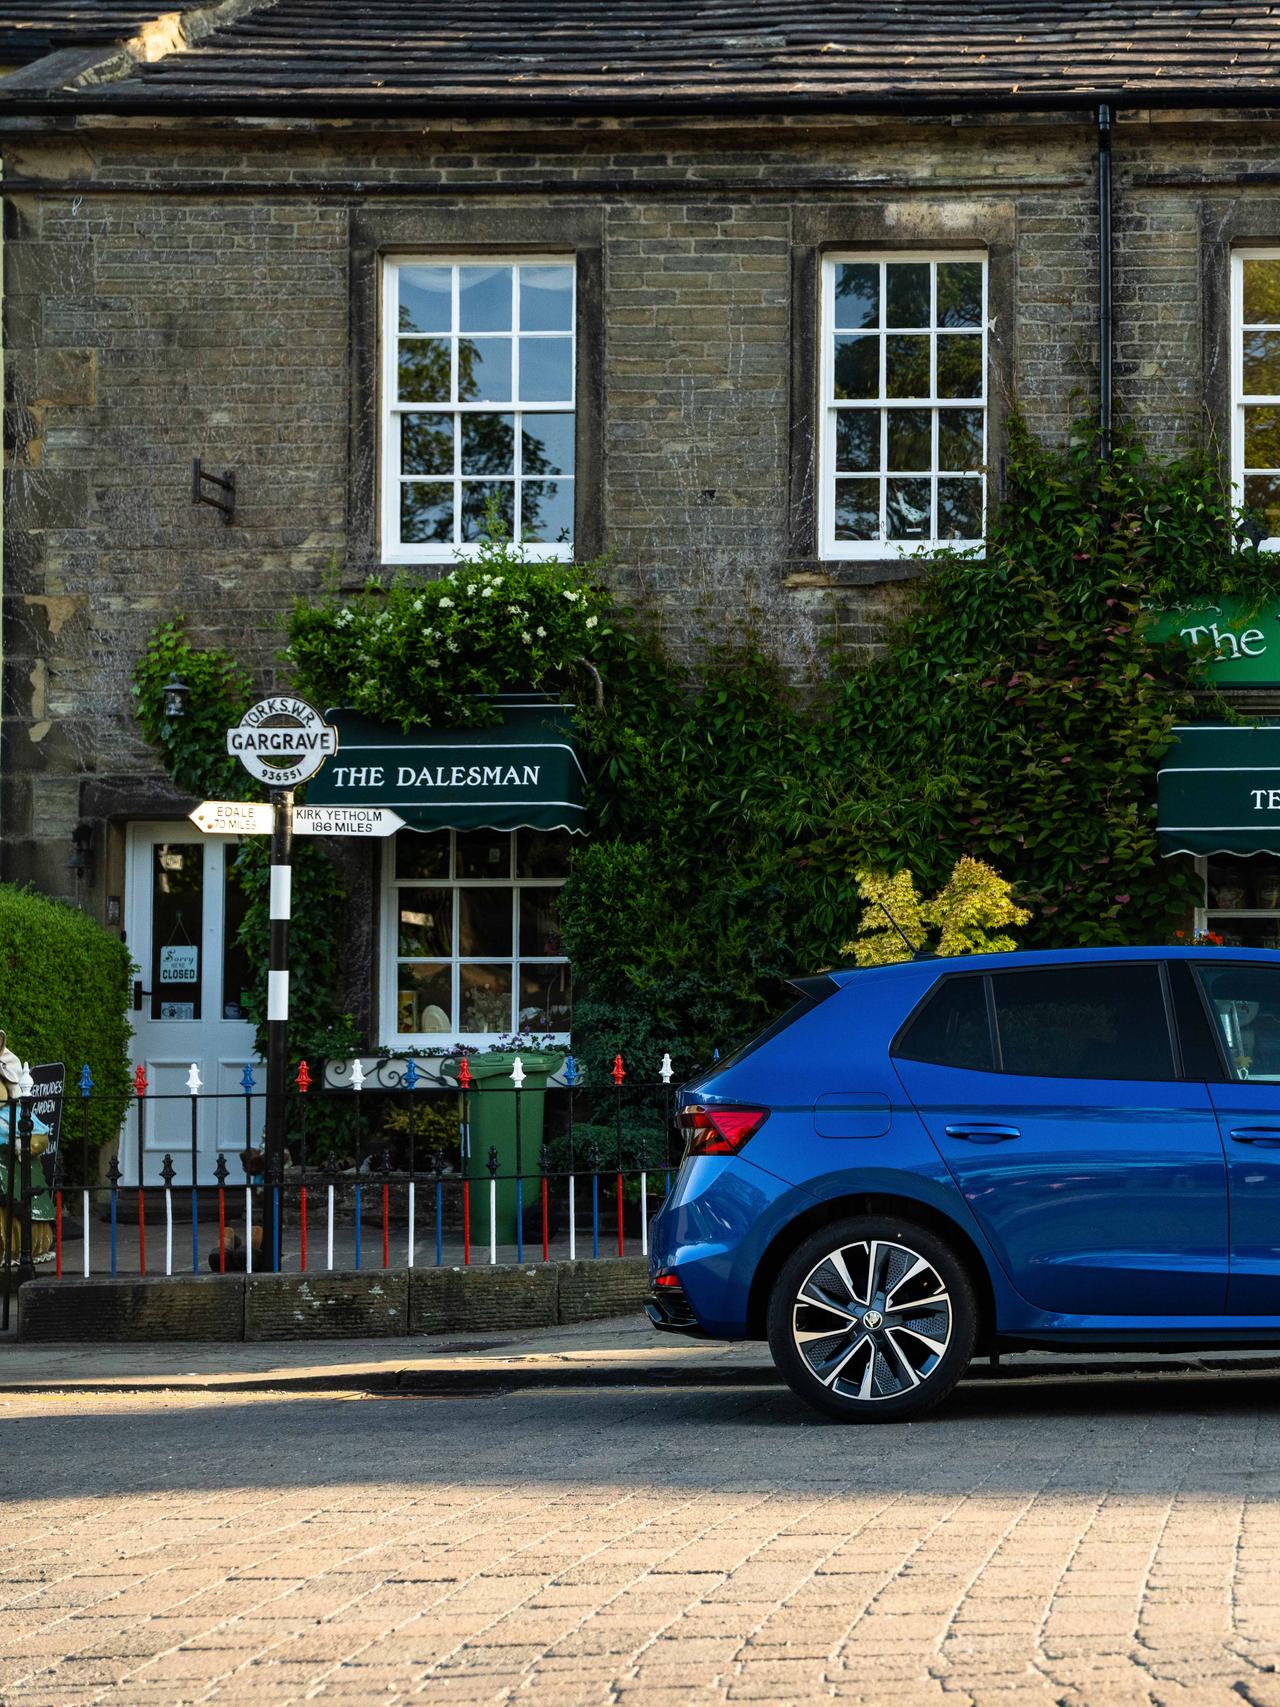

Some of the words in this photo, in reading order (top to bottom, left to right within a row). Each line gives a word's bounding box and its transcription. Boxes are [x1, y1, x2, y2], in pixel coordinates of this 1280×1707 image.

[1180, 623, 1267, 664] The
[231, 733, 331, 750] GARGRAVE
[261, 768, 303, 781] 936551
[332, 767, 385, 787] THE
[396, 766, 541, 787] DALESMAN
[217, 806, 255, 817] EDALE
[296, 809, 321, 820] KIRK
[326, 810, 382, 821] YETHOLM
[214, 819, 226, 829] 70
[312, 822, 332, 832] 186
[334, 822, 373, 832] MILES
[164, 949, 194, 965] Sorry
[162, 969, 196, 979] CLOSED
